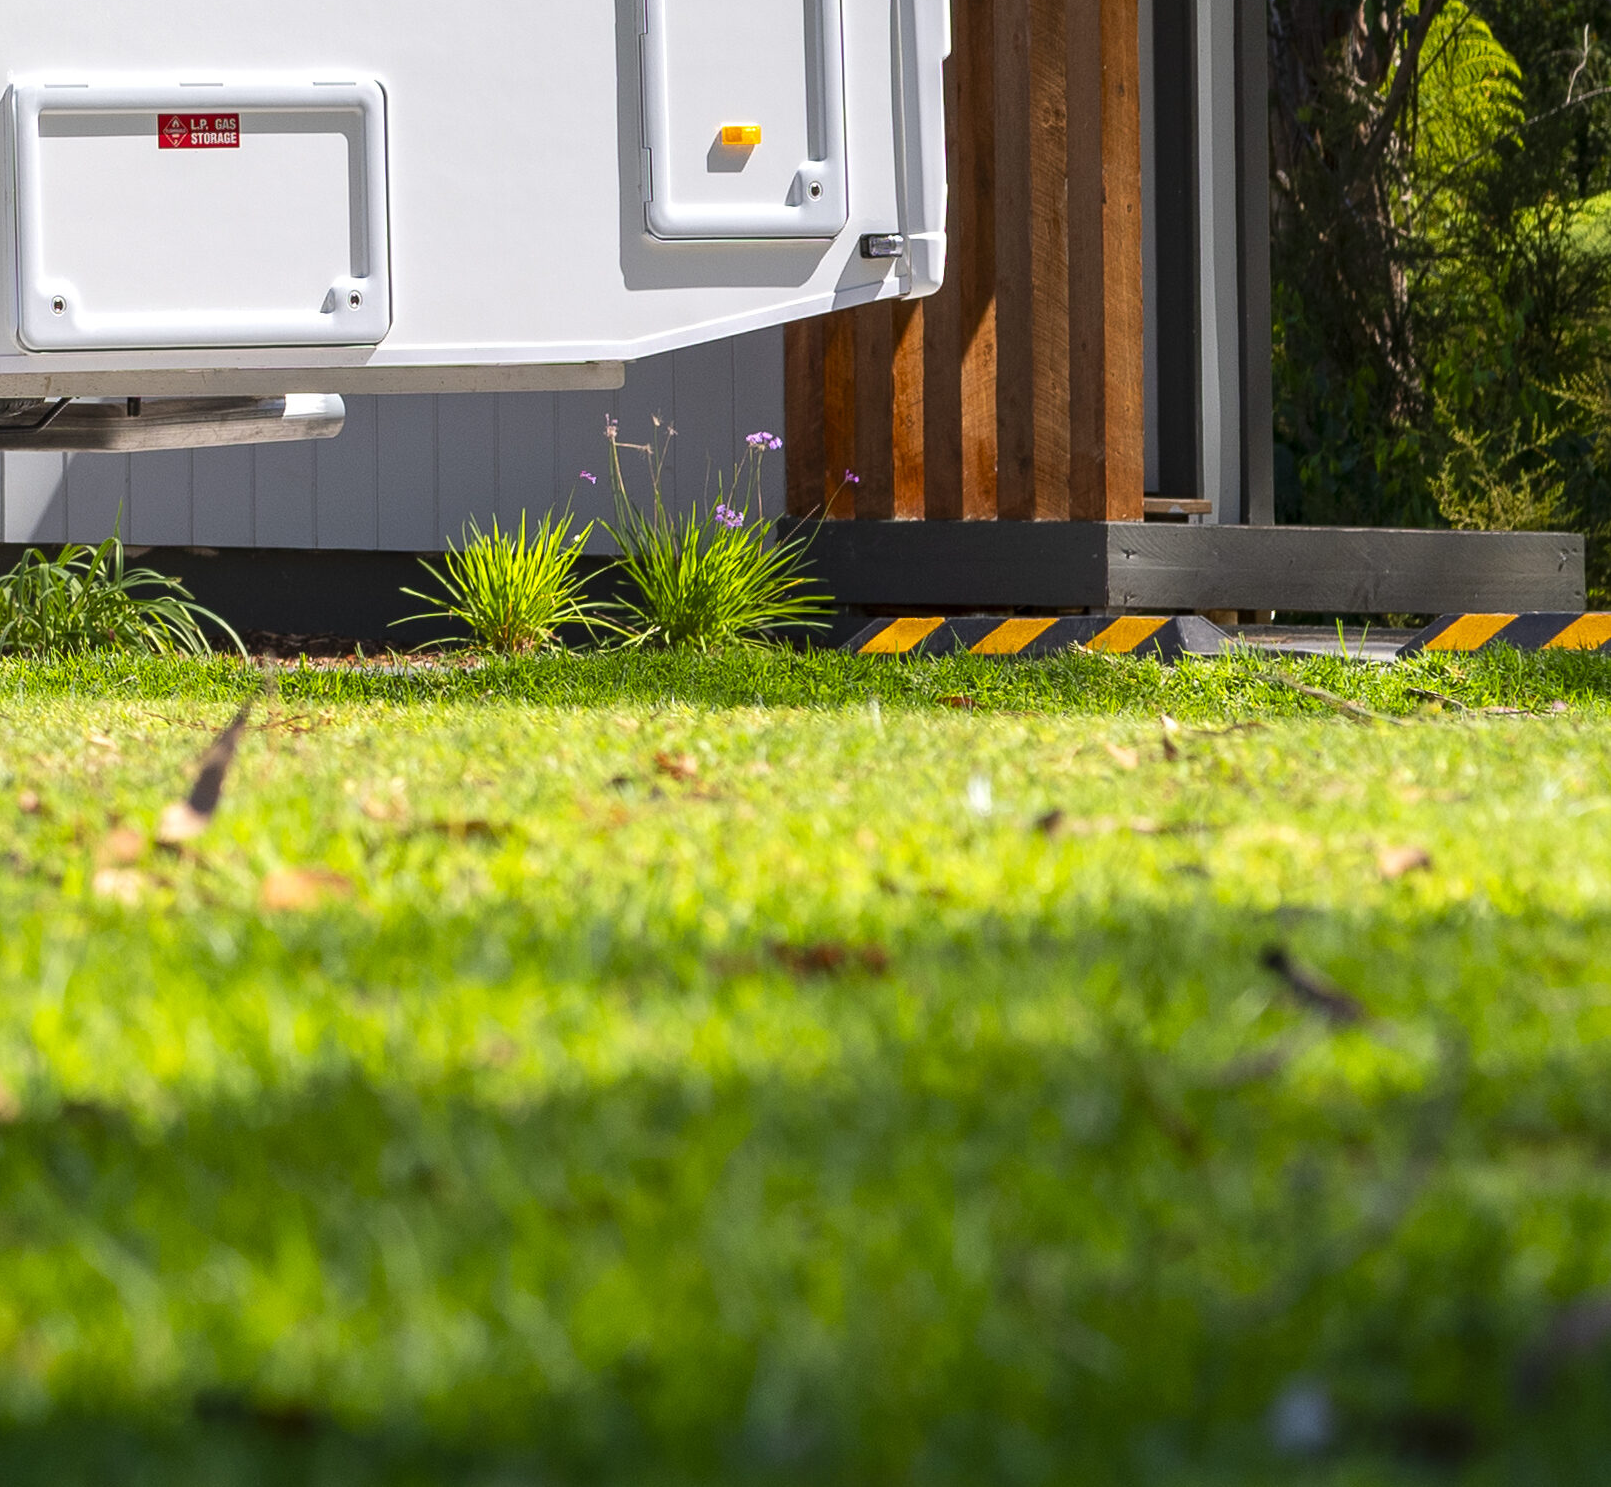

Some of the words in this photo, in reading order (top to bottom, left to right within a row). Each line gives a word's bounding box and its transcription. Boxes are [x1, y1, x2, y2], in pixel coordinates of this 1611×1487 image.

[190, 118, 209, 130] L.P.
[215, 118, 236, 130] GAS
[190, 132, 237, 145] STORAGE
